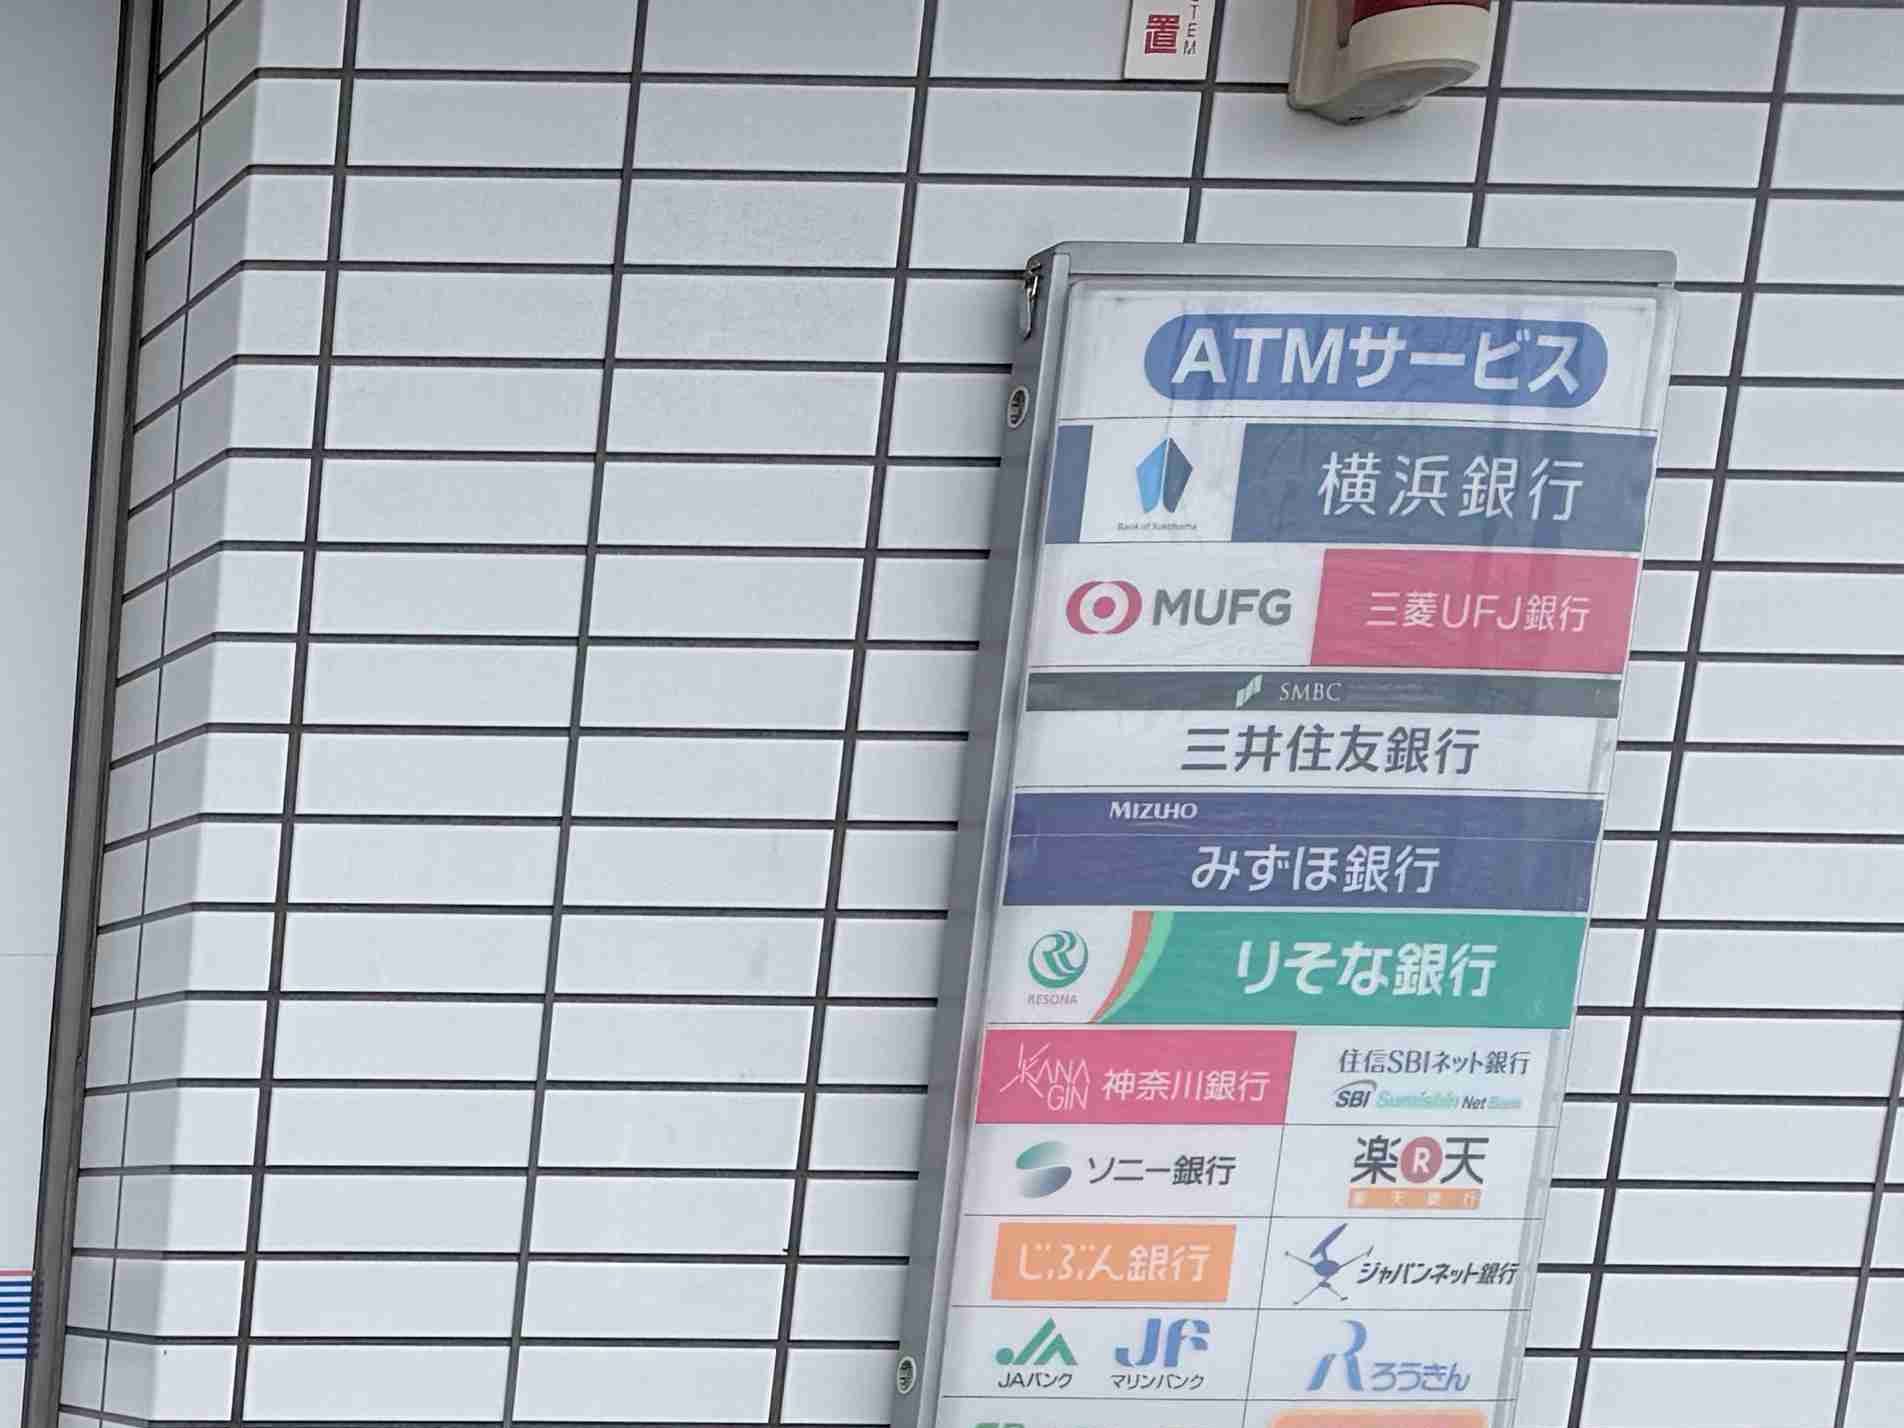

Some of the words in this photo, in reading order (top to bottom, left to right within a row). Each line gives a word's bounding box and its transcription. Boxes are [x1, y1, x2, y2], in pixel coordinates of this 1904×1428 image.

[1171, 325, 1581, 396] ATMサービス
[1317, 450, 1585, 522] 横浜銀行
[1151, 586, 1292, 628] MUFG
[1364, 589, 1591, 635] 三菱UFJ銀行
[1279, 679, 1342, 702] SMBC
[1179, 724, 1481, 777] 三井住友銀行
[1109, 801, 1198, 821] MIZUHO
[1191, 844, 1441, 895] みずほ銀行
[1237, 940, 1497, 999] りそな銀行
[1339, 1048, 1531, 1076] 住信SBIネット銀行
[1101, 1068, 1270, 1102] 神奈川銀行
[1335, 1089, 1370, 1109] SBI
[1087, 1155, 1237, 1187] ソニー銀行
[1016, 1243, 1210, 1284] じぶん銀行
[1357, 1259, 1520, 1288] ジャパンネット銀行
[997, 1371, 1074, 1389] JAバンク
[1110, 1373, 1205, 1391] マリンバンク
[1371, 1361, 1470, 1392] ろうきん
